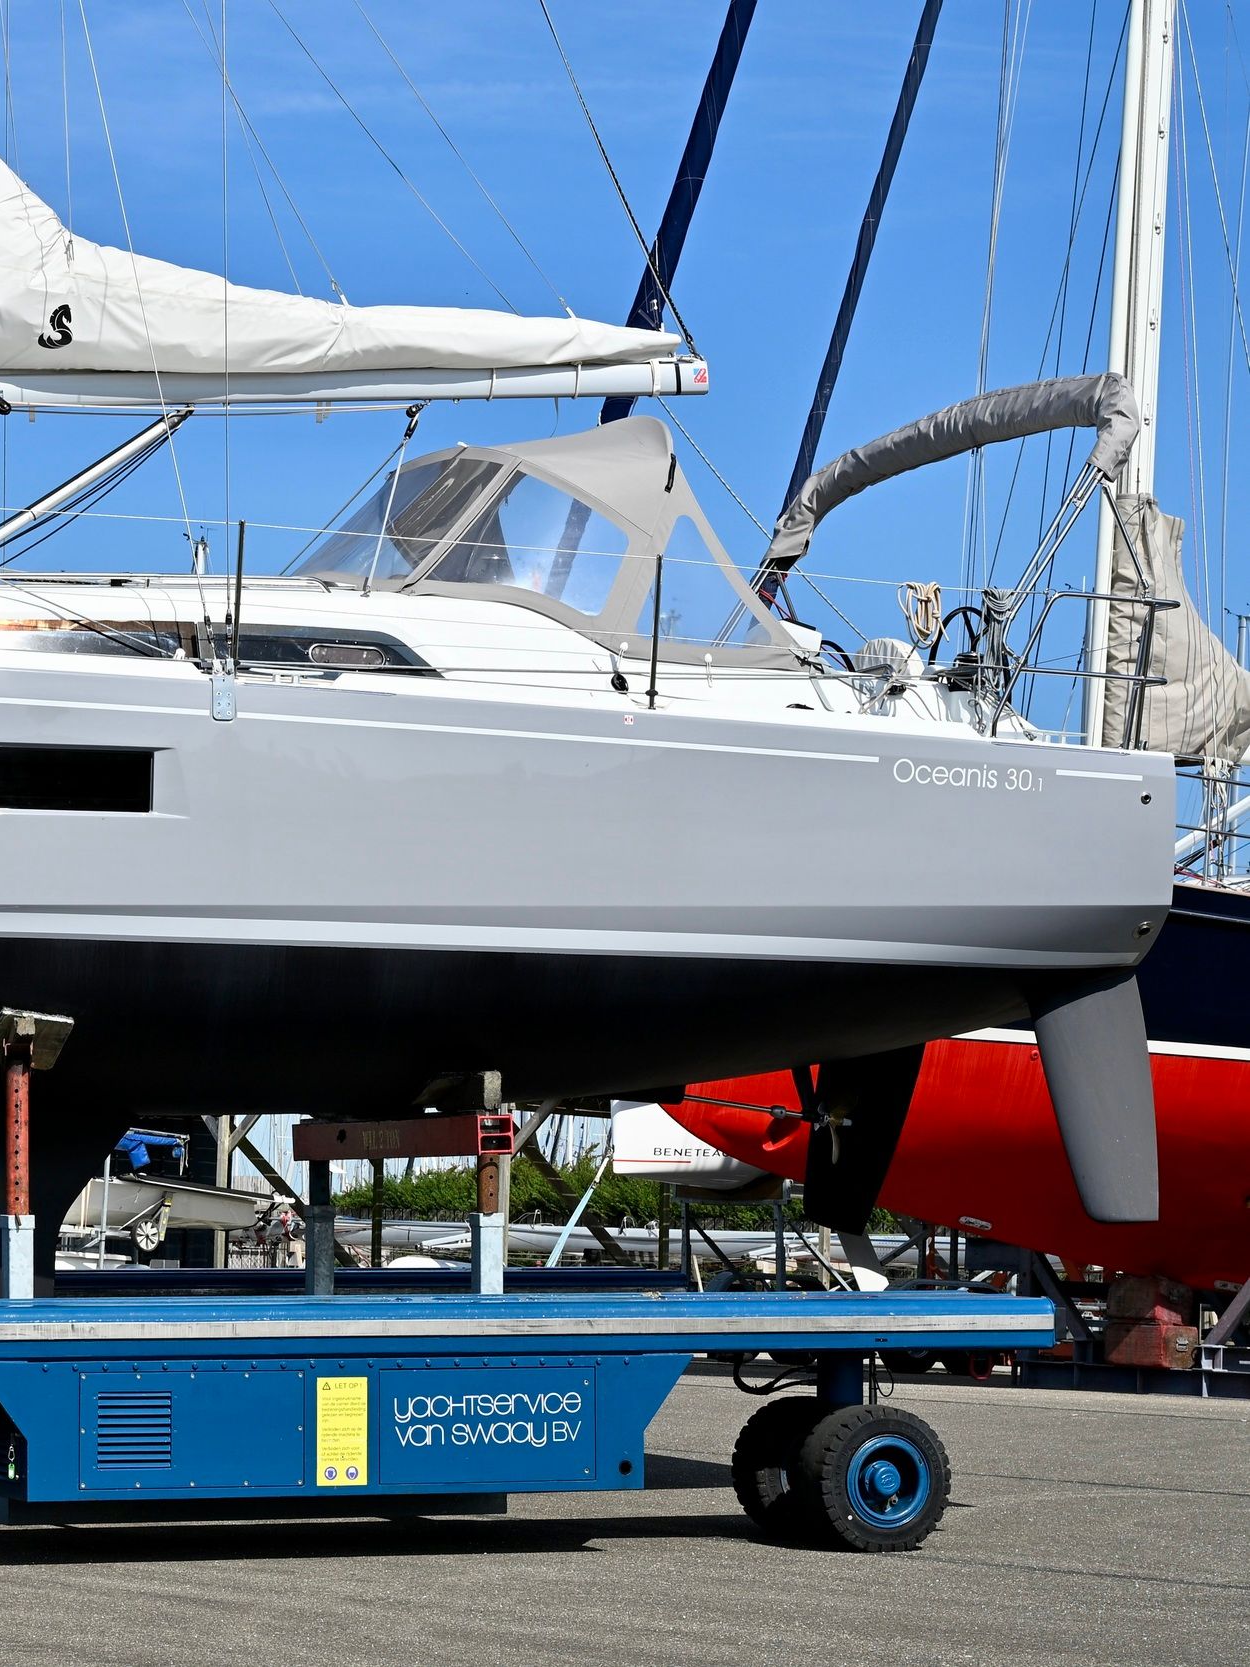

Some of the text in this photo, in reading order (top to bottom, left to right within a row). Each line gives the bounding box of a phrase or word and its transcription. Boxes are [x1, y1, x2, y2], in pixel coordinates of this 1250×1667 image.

[893, 758, 1044, 792] Oceanis 30.1
[334, 1382, 347, 1390] LET
[348, 1382, 359, 1390] OP
[395, 1420, 582, 1447] van swaay BV
